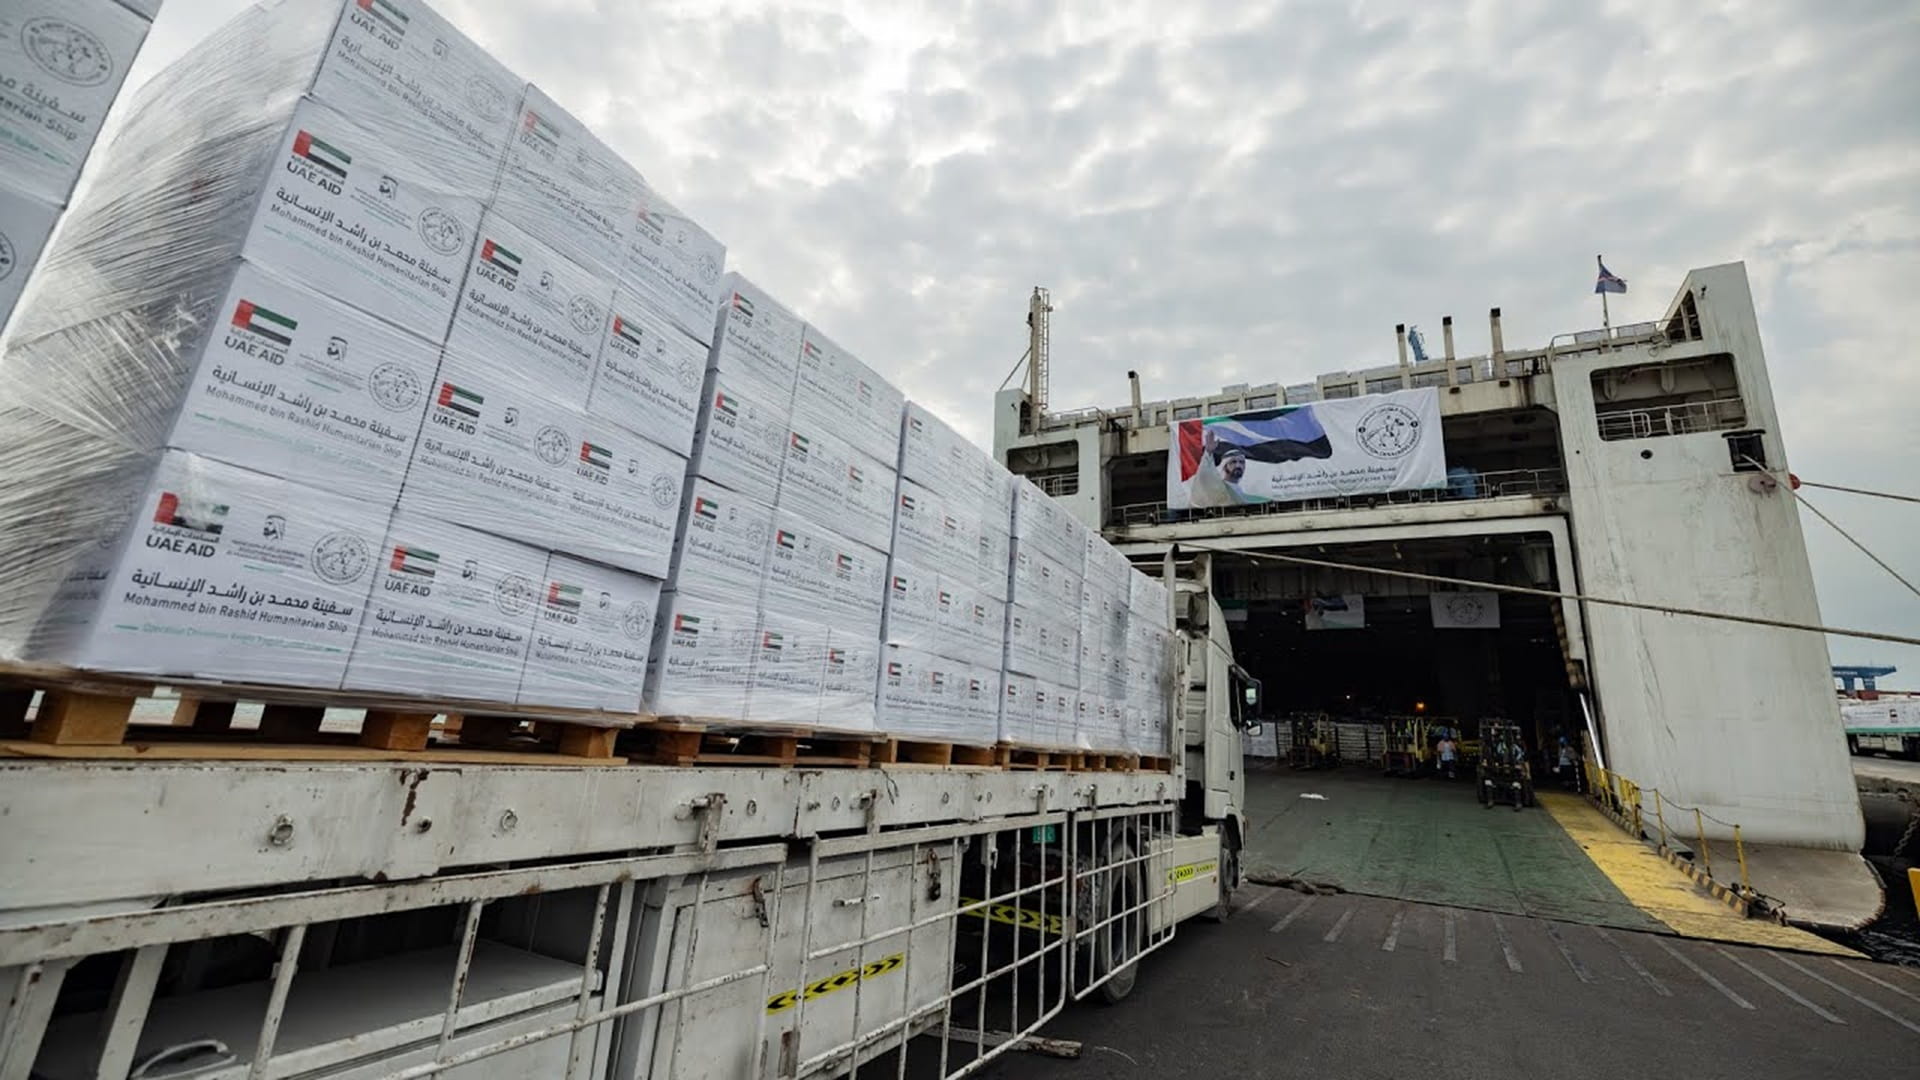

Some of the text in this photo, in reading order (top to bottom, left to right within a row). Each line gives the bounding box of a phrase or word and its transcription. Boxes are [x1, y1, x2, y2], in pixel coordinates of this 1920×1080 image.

[45, 118, 77, 141] Ship
[287, 160, 316, 184] UAE
[317, 178, 342, 195] AID
[276, 187, 335, 224] الإنسانية
[271, 203, 328, 237] Mohammed
[329, 232, 344, 245] bin
[345, 239, 376, 261] Rashid
[335, 219, 367, 243] راشد
[383, 243, 417, 266] محمد
[418, 259, 451, 284] سفينة
[476, 265, 498, 283] UAE
[497, 278, 516, 292] AID
[224, 335, 257, 357] UAE
[258, 349, 285, 366] AID
[212, 364, 277, 399] الإنسانية
[206, 384, 268, 413] Mohammed
[269, 406, 285, 419] bin
[287, 411, 320, 433] Rashid
[277, 391, 312, 413] راشد
[313, 403, 328, 418] بن
[329, 410, 367, 429] محمد
[369, 420, 406, 442] سفينة
[432, 413, 457, 428] UAE
[457, 422, 476, 435] AID
[145, 534, 184, 553] UAE
[184, 542, 216, 558] AID
[131, 568, 354, 616] سفينة محمد بن راشد الإنسانية
[385, 580, 410, 593] UAE
[410, 584, 431, 597] AID
[124, 591, 348, 633] Mohammed bin Rashid Humanitarian Ship
